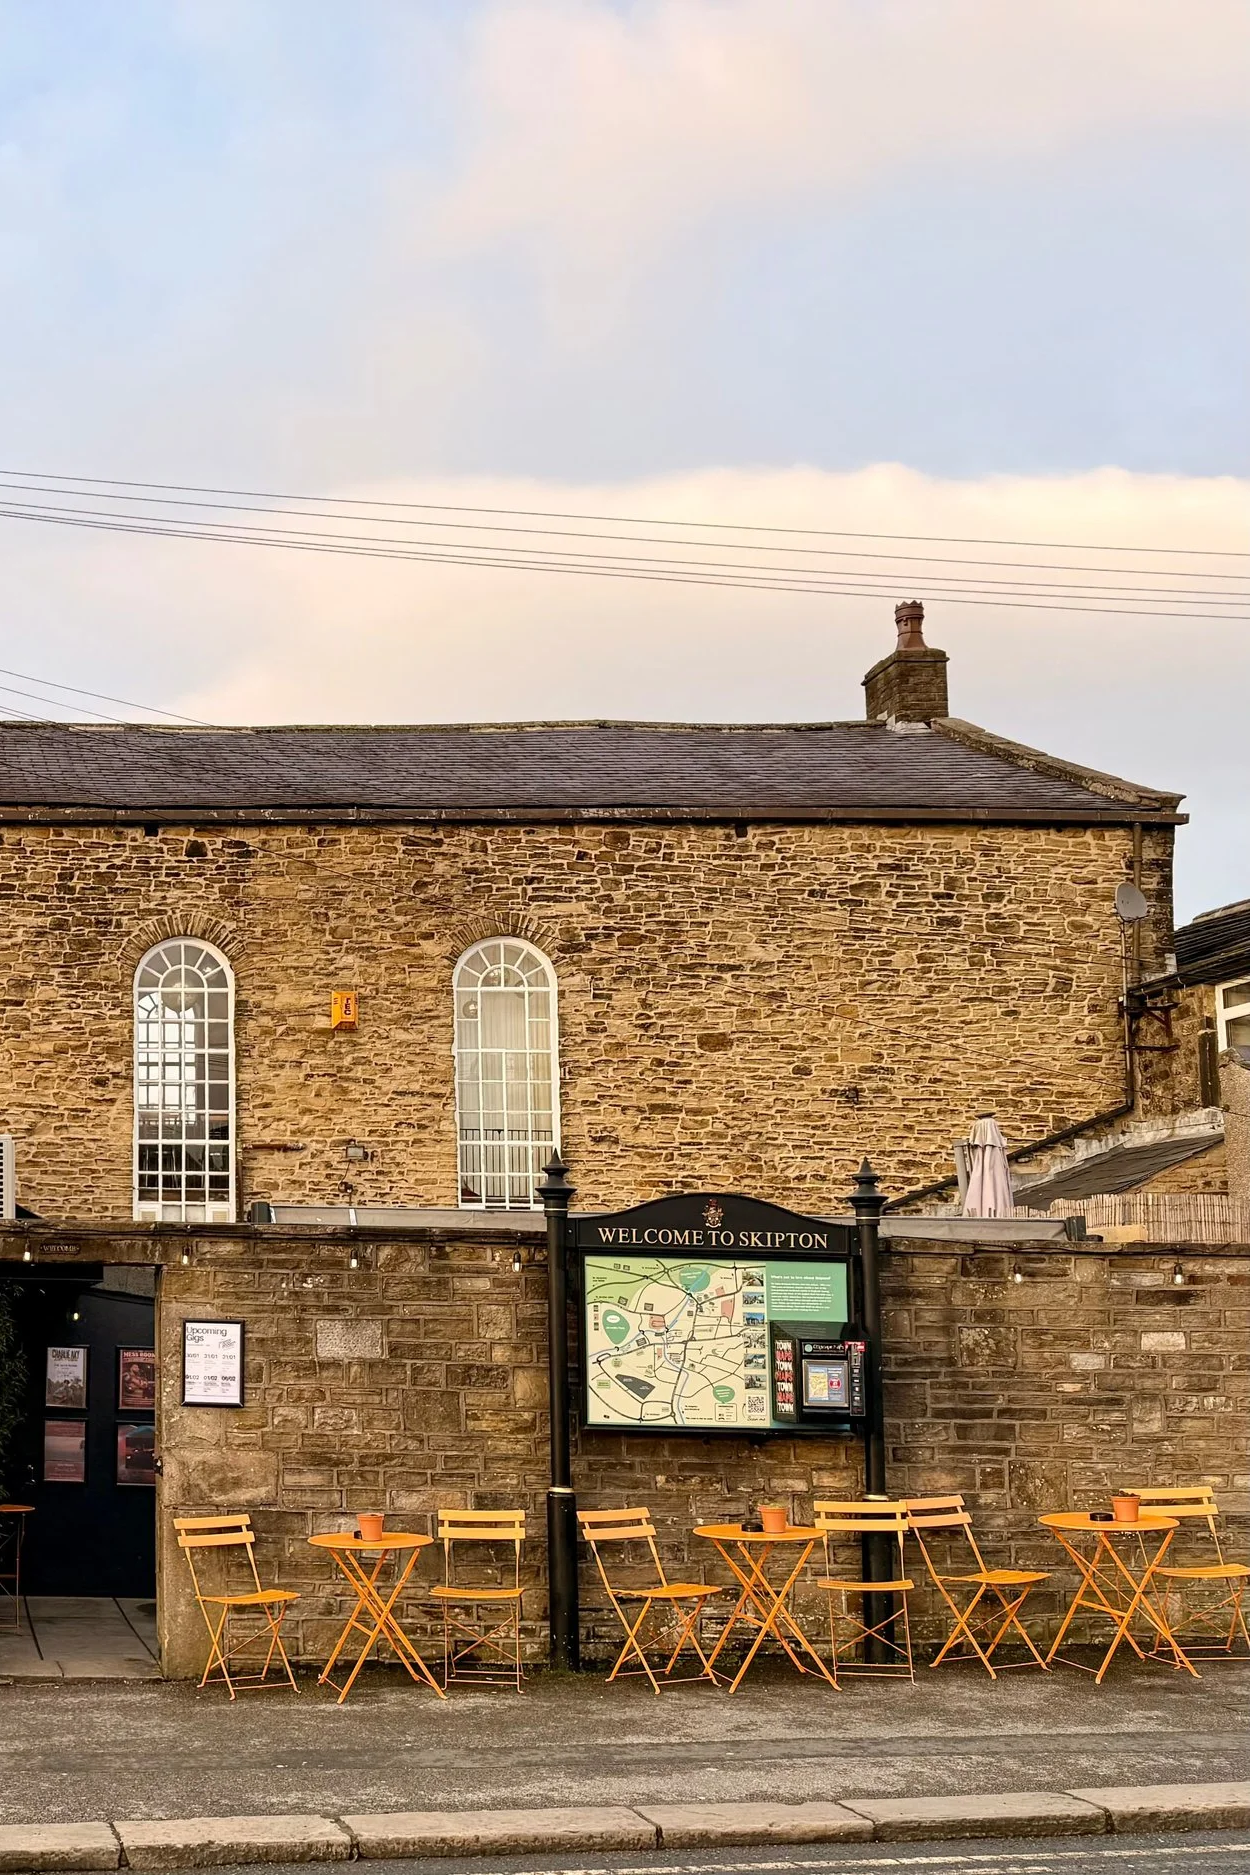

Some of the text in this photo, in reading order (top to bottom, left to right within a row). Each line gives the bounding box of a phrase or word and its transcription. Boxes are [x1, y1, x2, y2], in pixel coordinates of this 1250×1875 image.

[599, 1227, 828, 1249] WELCOME TO SKIPTON
[186, 1326, 227, 1337] Upcoming
[186, 1334, 204, 1344] Gigs
[776, 1341, 792, 1351] TOWN
[776, 1351, 793, 1361] MAPS
[776, 1361, 793, 1371] TOWN
[777, 1382, 793, 1392] TOWN
[777, 1403, 794, 1413] TOWN
